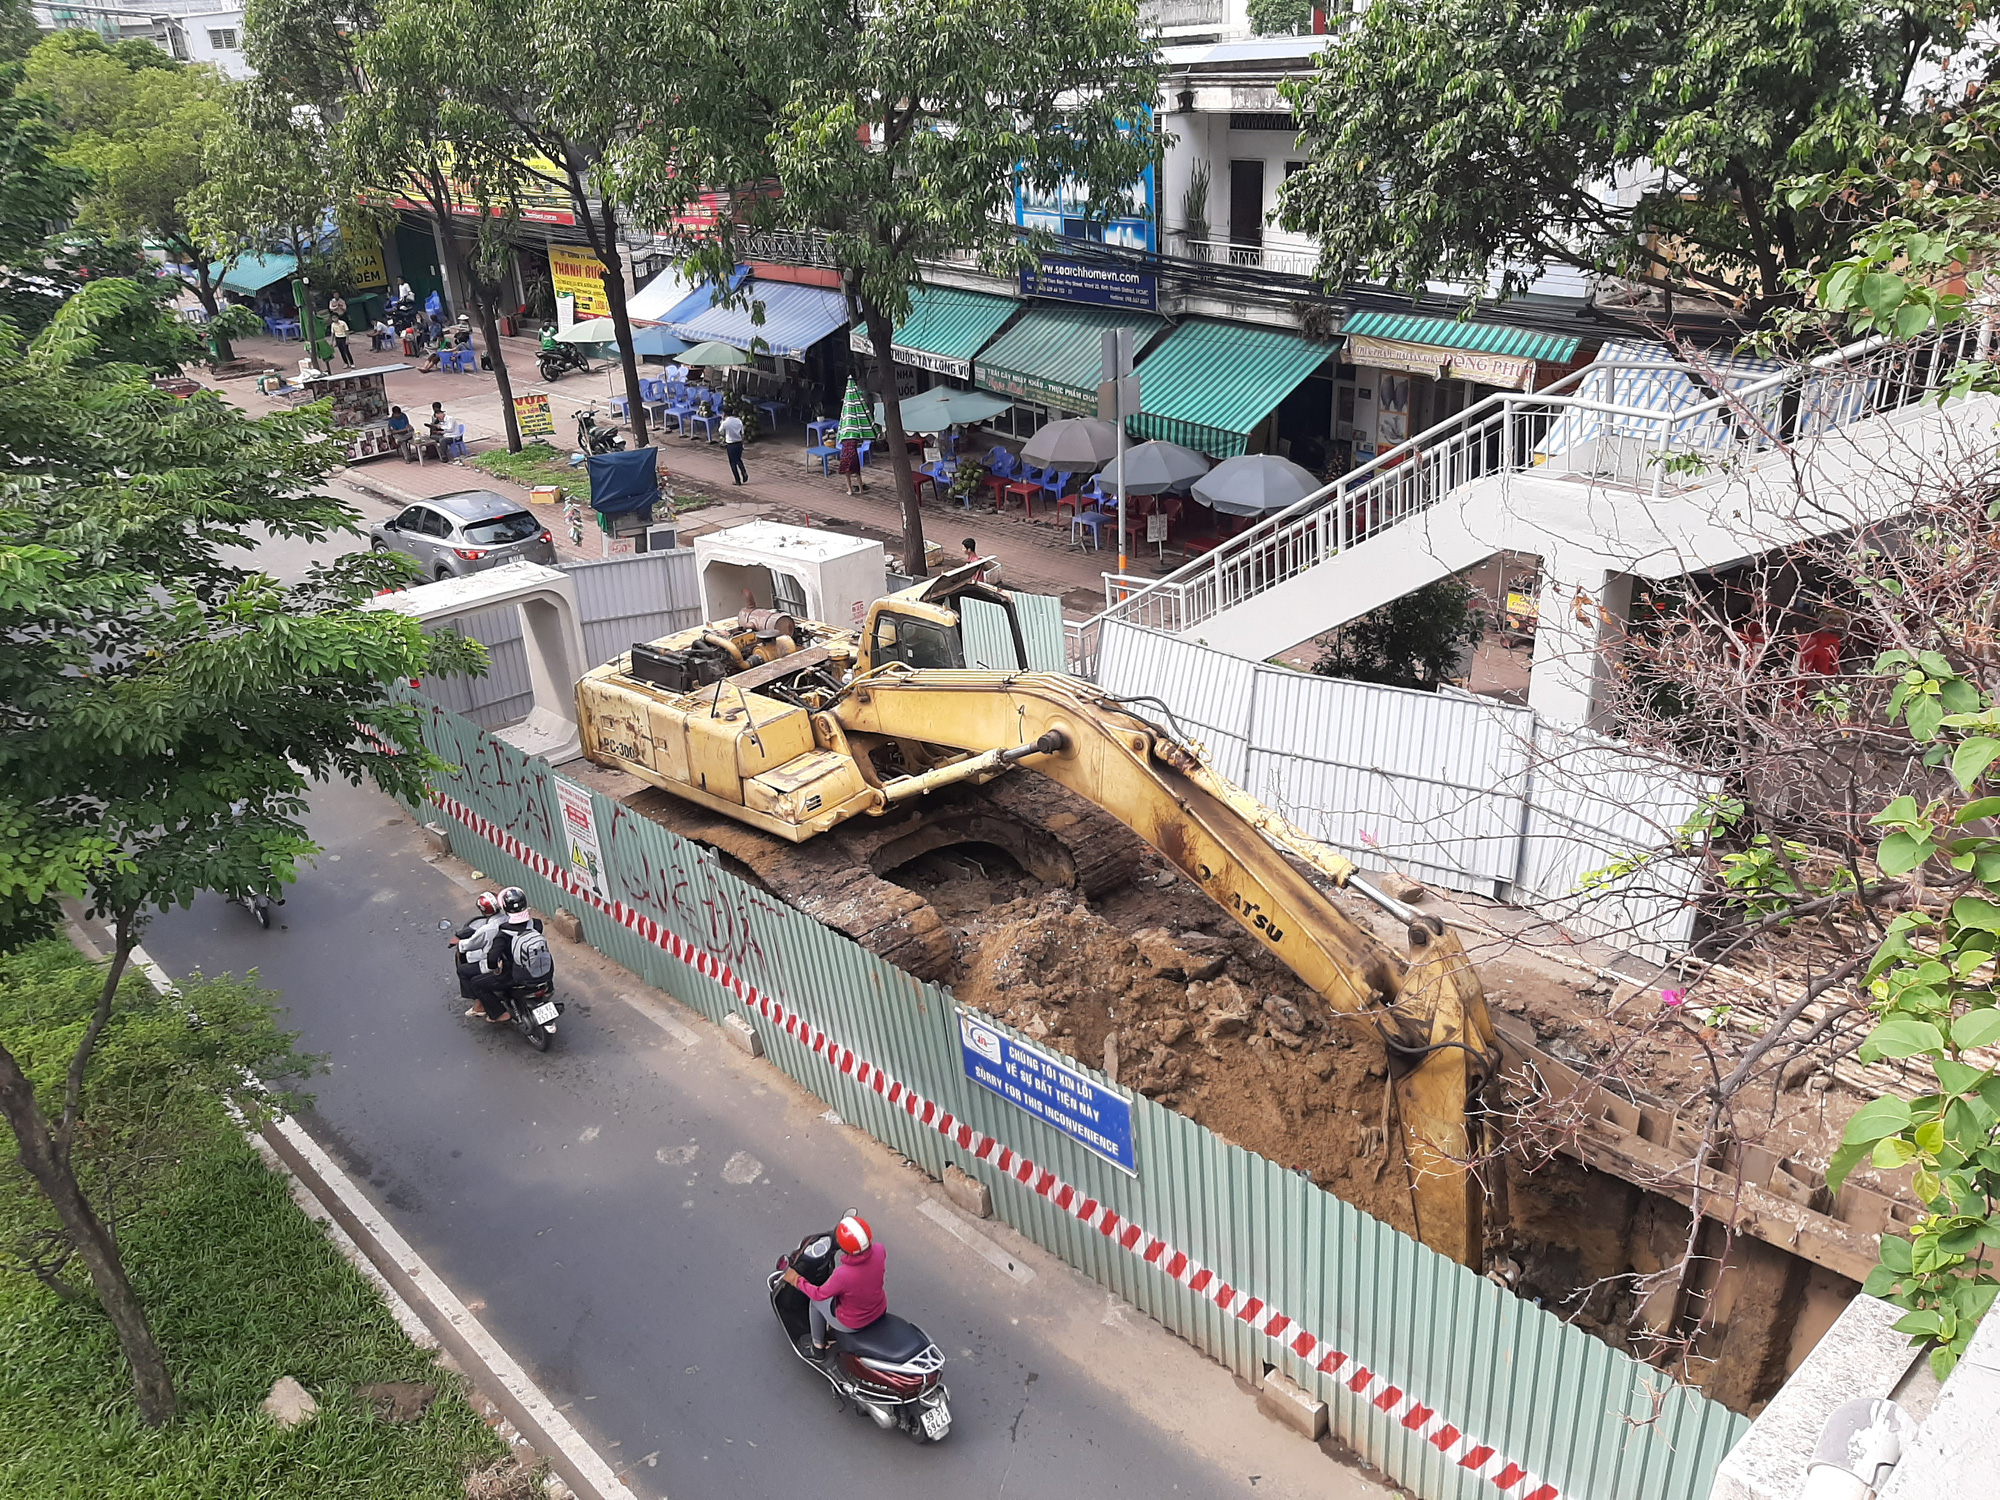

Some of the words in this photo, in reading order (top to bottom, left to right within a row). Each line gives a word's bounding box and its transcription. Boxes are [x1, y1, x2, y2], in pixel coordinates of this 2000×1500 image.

[1008, 1045, 1039, 1071] CHÚNG
[1040, 1061, 1057, 1081] TÔI
[1059, 1073, 1075, 1092] XIN
[975, 1065, 1002, 1088] SORRY
[1004, 1082, 1022, 1101] FOR
[1023, 1092, 1043, 1113] THIS
[1045, 1104, 1119, 1156] INCONVENIENCE
